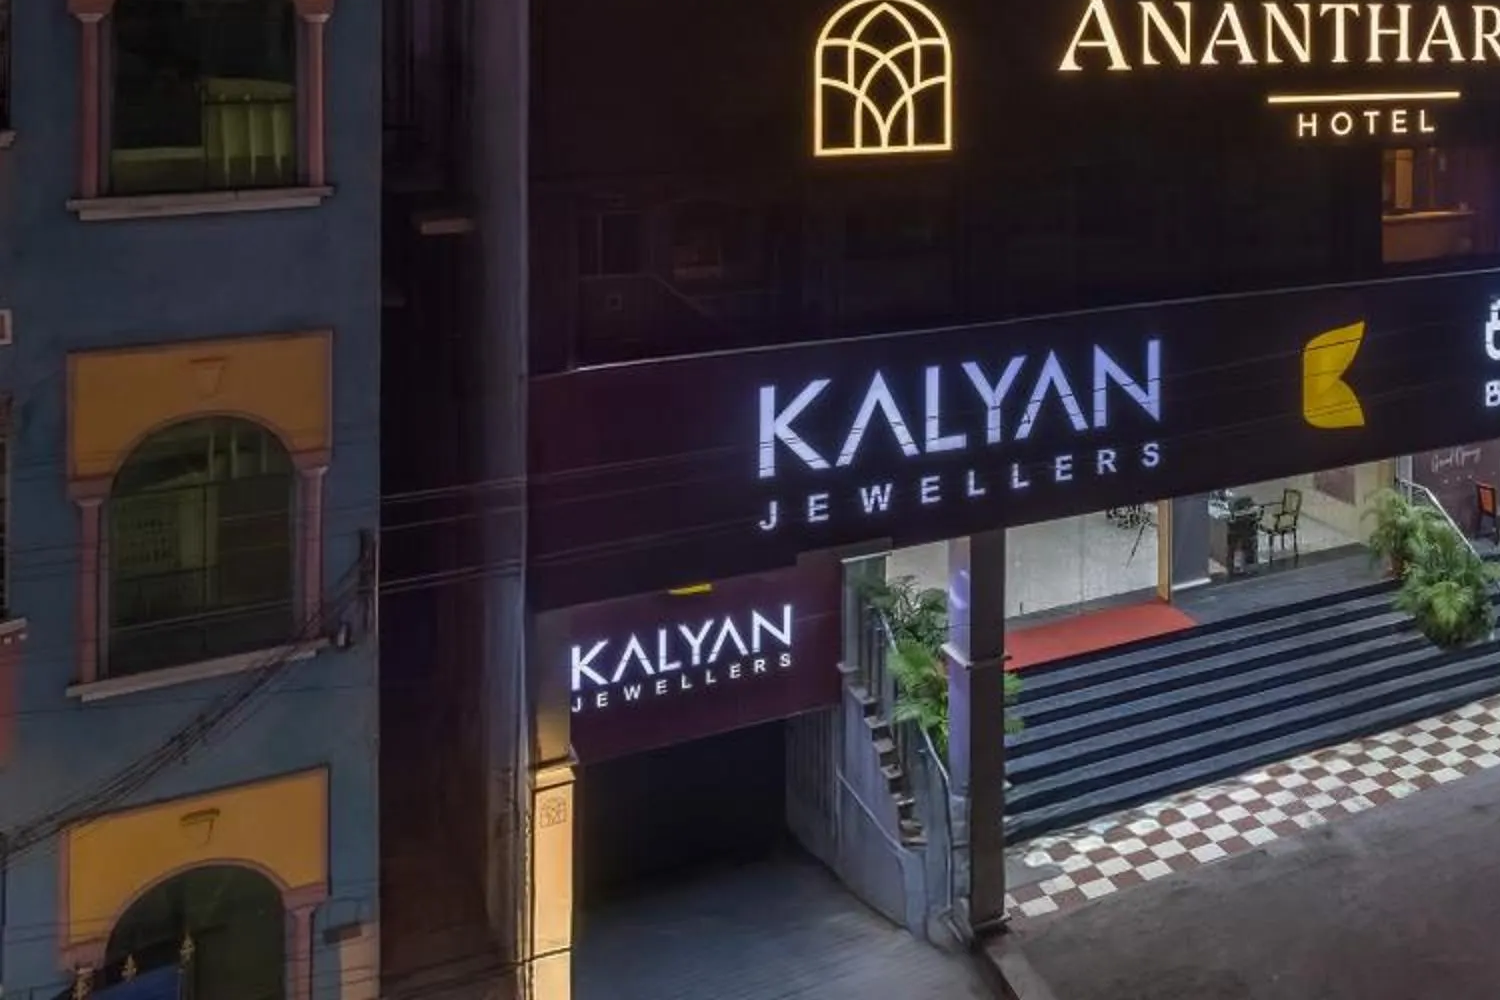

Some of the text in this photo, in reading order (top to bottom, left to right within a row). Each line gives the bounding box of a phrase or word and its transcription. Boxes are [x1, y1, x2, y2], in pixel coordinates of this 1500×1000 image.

[1297, 109, 1436, 137] HOTEL
[758, 339, 1162, 479] KALYAN
[758, 442, 1162, 532] JEWELLERS
[570, 604, 793, 690] KALYAN
[570, 652, 793, 714] JEWELLERS
